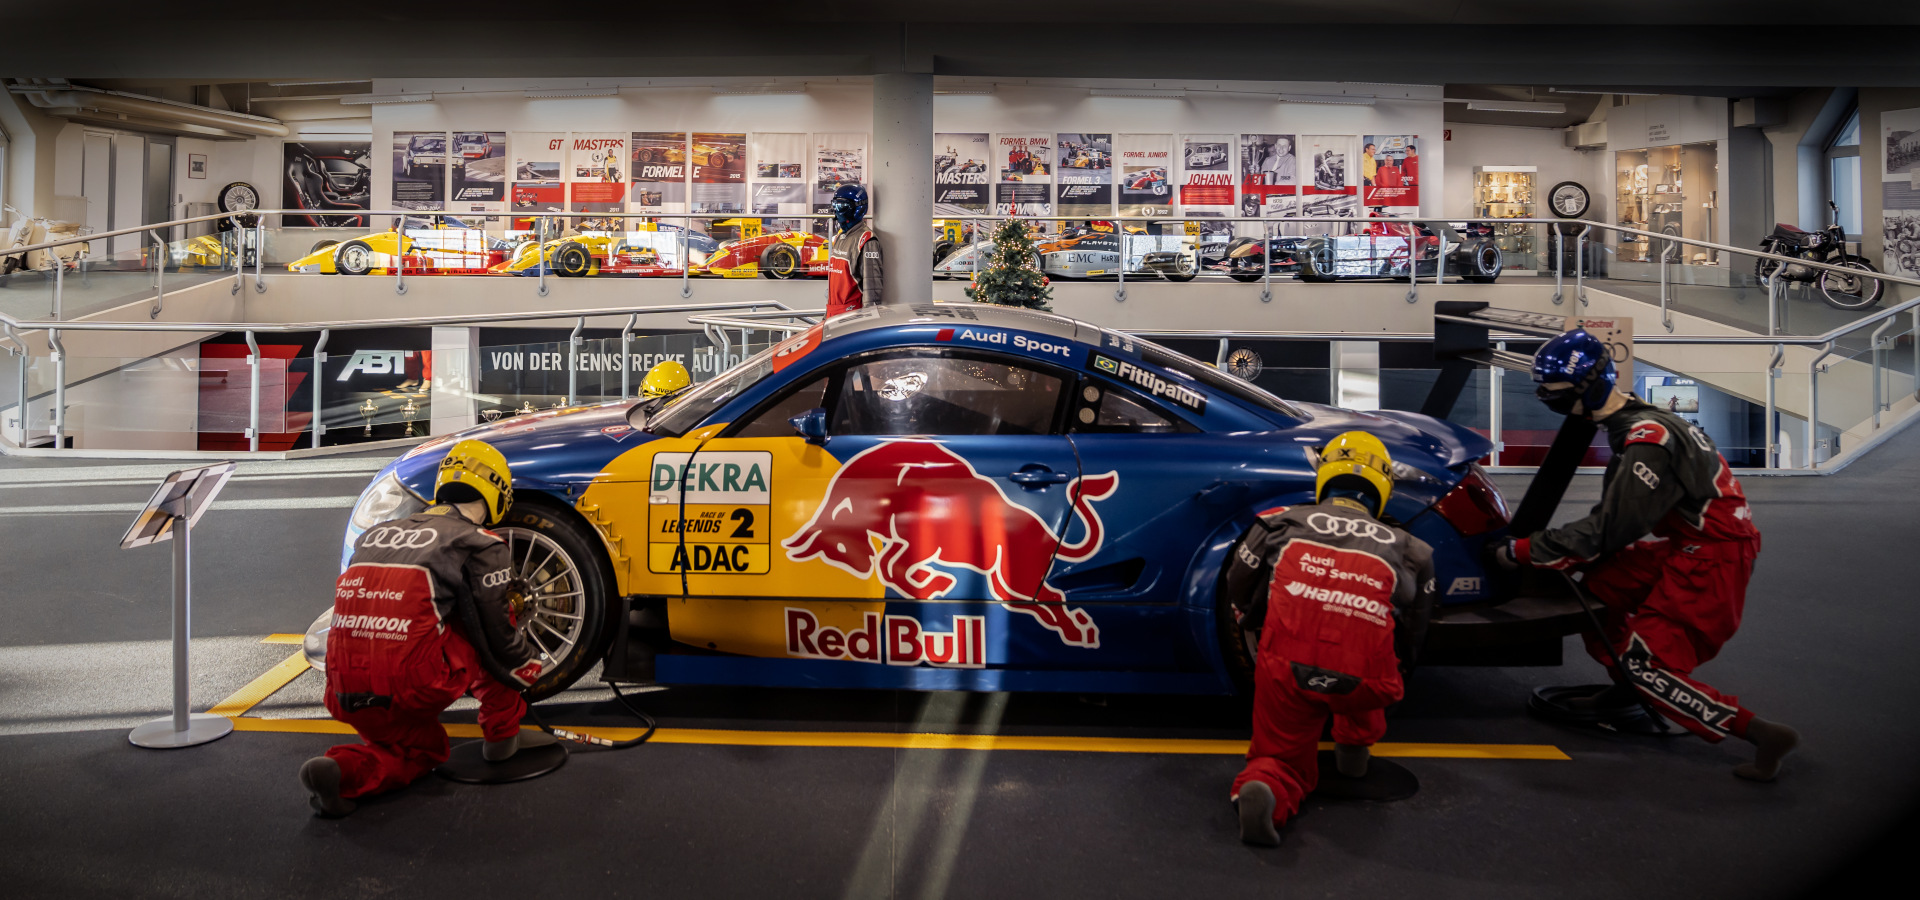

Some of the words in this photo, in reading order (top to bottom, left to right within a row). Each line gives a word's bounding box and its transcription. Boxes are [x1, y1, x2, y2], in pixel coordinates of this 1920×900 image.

[549, 139, 564, 151] GT
[573, 139, 624, 151] MASTERS
[1000, 138, 1027, 146] FORMEL
[1029, 138, 1049, 146] BMW
[641, 165, 684, 178] FORMEL
[693, 166, 701, 178] E
[936, 172, 987, 184] MASTERS
[1063, 176, 1092, 184] FORMEL
[1094, 176, 1100, 184] 3
[1188, 173, 1233, 186] JOHANN
[1244, 173, 1267, 185] ABT
[1585, 319, 1615, 329] Castrol
[960, 329, 1007, 345] Audi
[1013, 335, 1071, 357] Sport
[337, 350, 405, 382] ABT
[491, 351, 524, 371] VON
[529, 352, 562, 371] DER
[1118, 361, 1200, 410] Fittipaldi
[653, 463, 767, 493] DEKRA
[661, 519, 722, 534] LEGENDS
[729, 507, 755, 539] 2
[669, 545, 750, 572] ADAC
[1300, 552, 1335, 567] Audi
[338, 576, 364, 587] Audi
[1299, 561, 1326, 577] Top
[1328, 568, 1383, 590] Service
[1446, 576, 1481, 596] ABT
[336, 587, 354, 600] Top
[356, 587, 405, 601] Service
[351, 629, 375, 641] driving
[375, 630, 408, 642] emotion
[783, 605, 882, 665] Red
[884, 613, 986, 668] Bull
[1669, 687, 1719, 722] Audi
